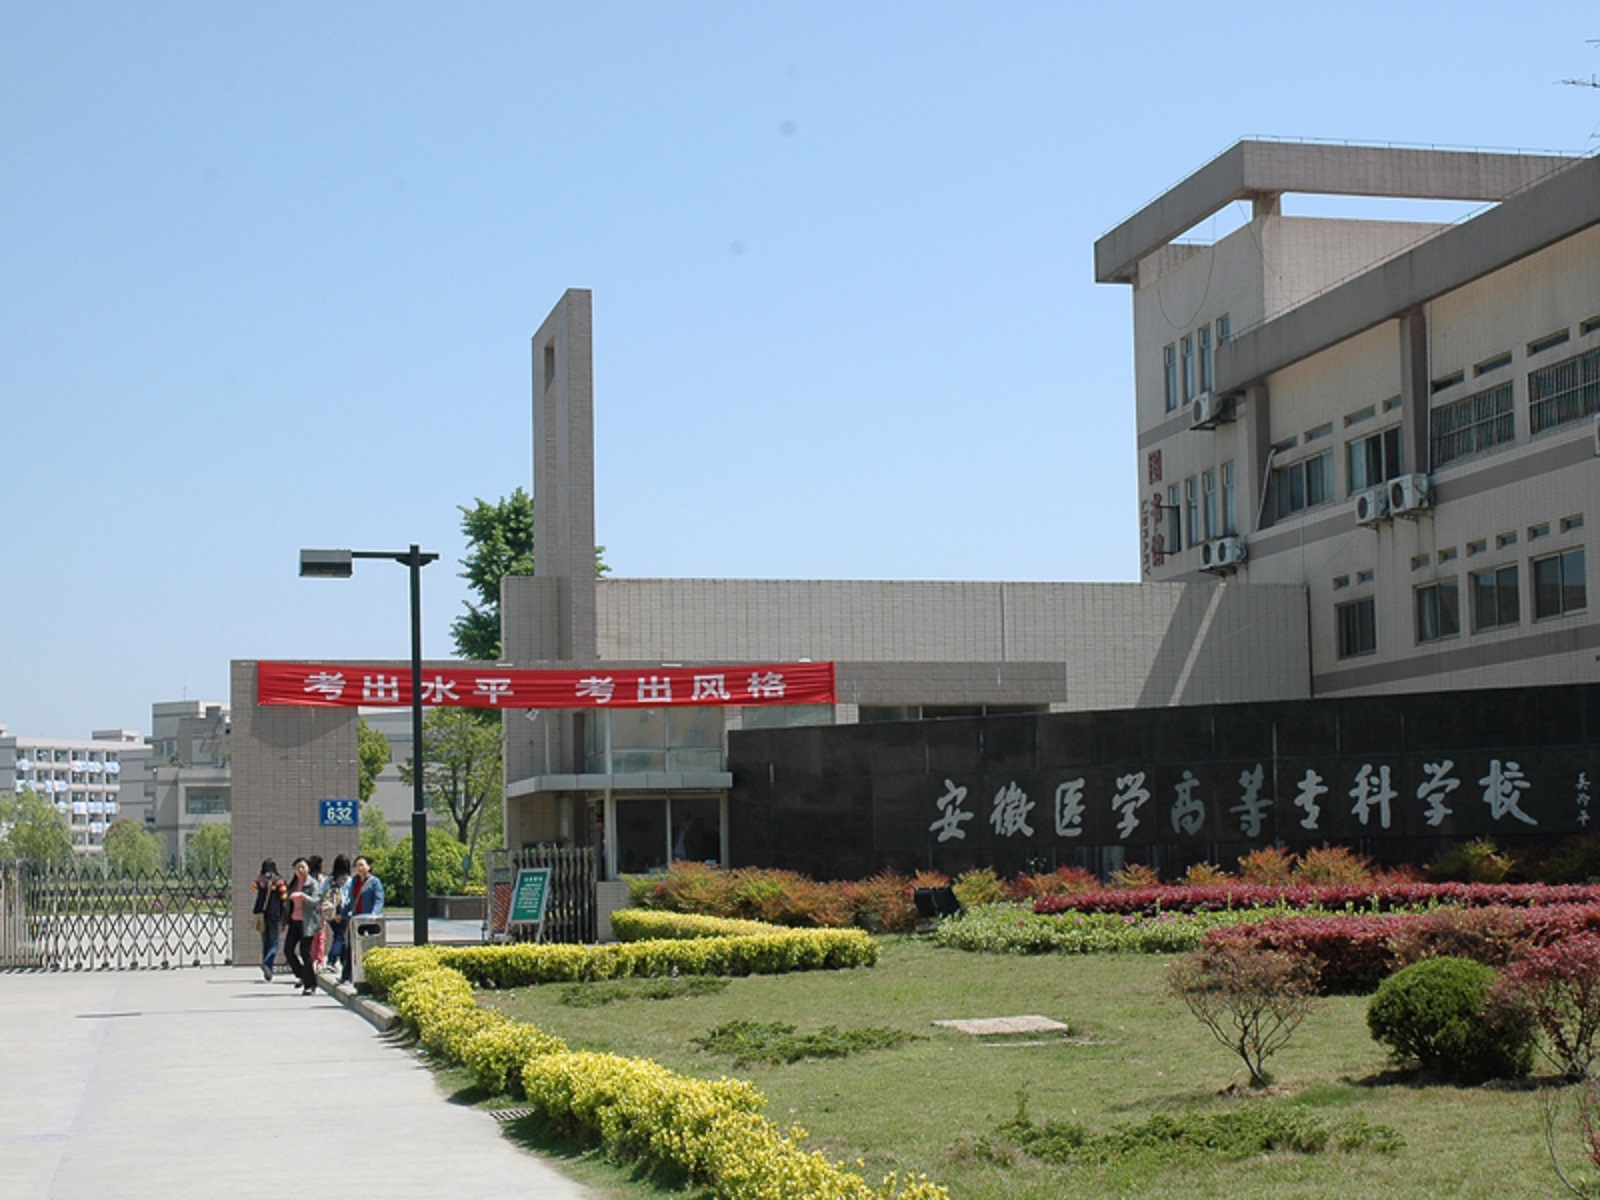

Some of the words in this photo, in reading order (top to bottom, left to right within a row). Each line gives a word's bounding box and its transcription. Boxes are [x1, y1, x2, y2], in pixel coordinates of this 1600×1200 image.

[303, 672, 514, 704] 考出水平
[575, 672, 786, 704] 考出风格
[327, 807, 352, 820] 632
[929, 759, 1538, 842] 安徽医学高等专科学校
